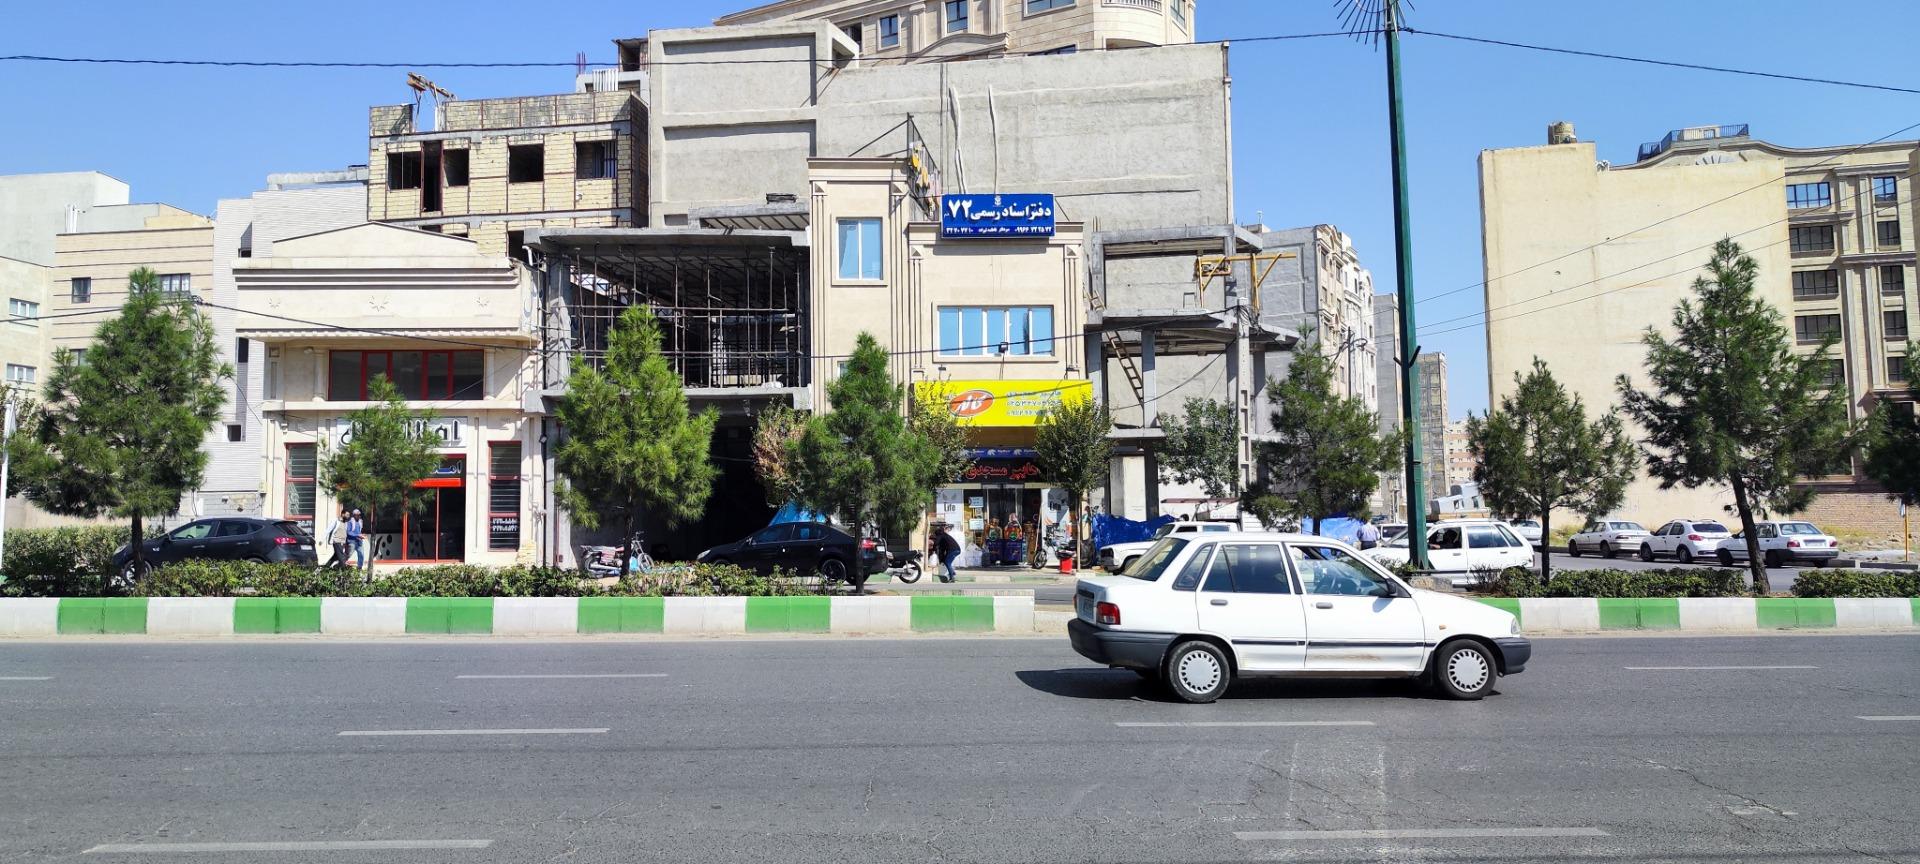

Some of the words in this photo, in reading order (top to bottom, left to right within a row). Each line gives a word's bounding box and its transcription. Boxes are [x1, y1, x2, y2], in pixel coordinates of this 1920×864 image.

[948, 199, 973, 219] ۷۲
[970, 208, 1001, 221] رسمی
[1002, 203, 1029, 217] اسناد
[1028, 202, 1052, 220] دفتر
